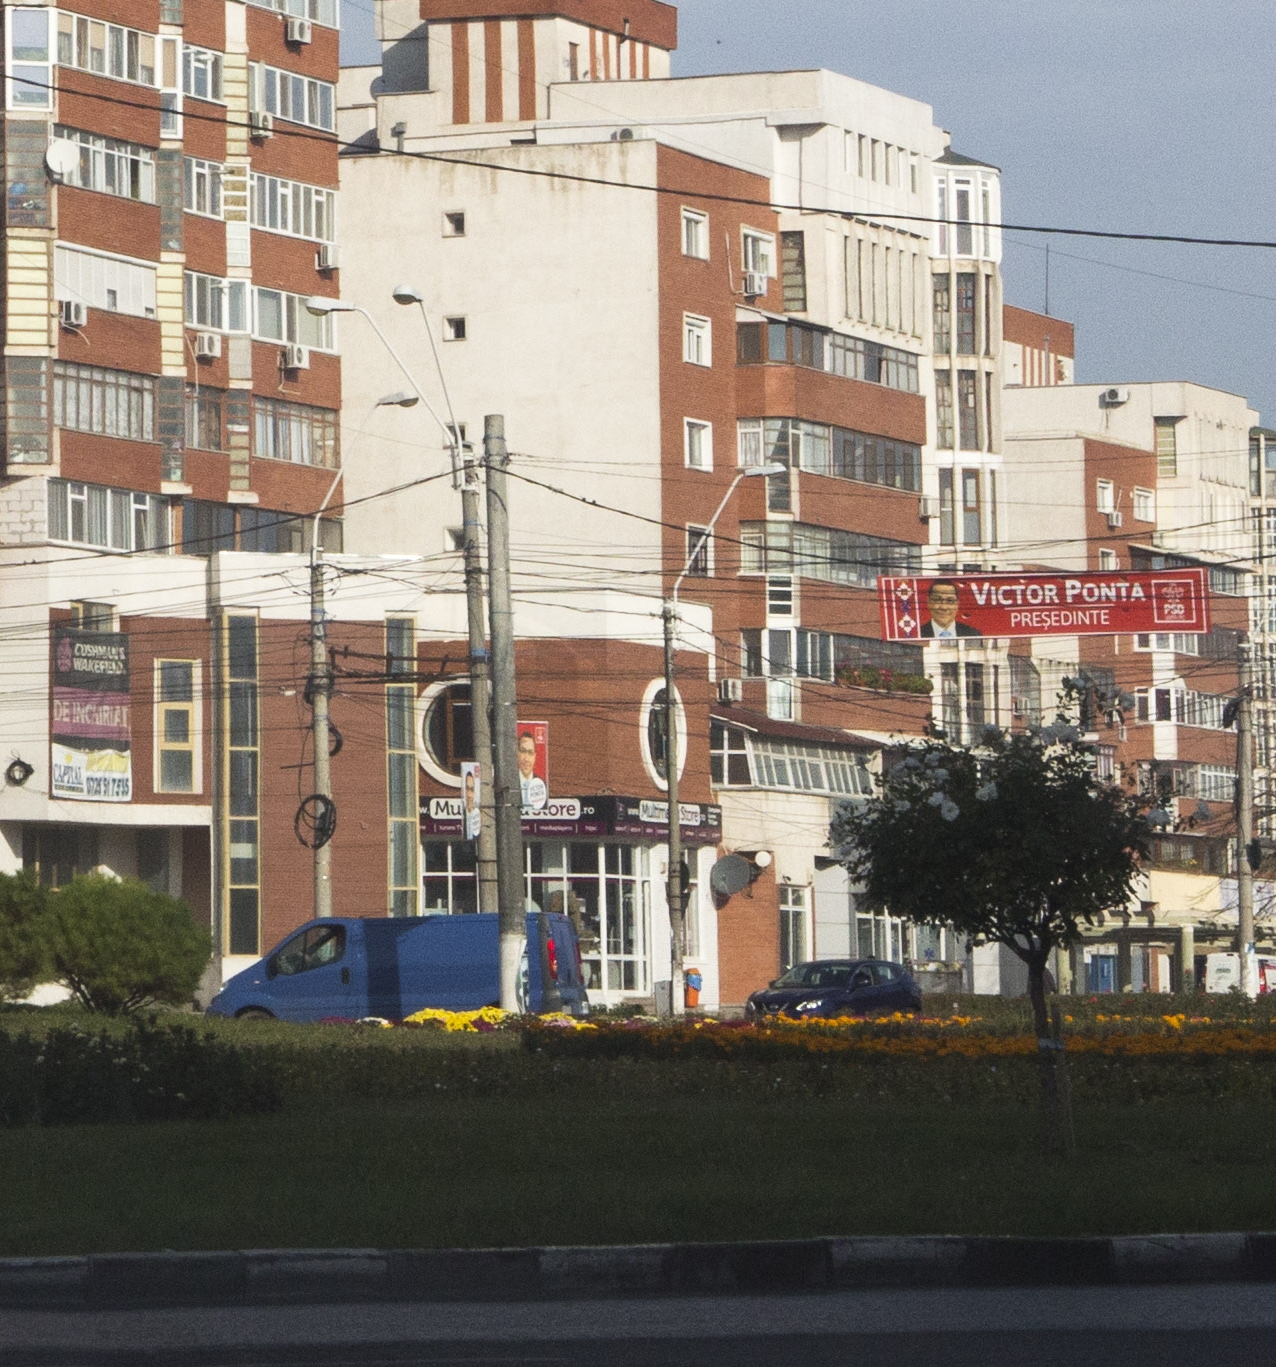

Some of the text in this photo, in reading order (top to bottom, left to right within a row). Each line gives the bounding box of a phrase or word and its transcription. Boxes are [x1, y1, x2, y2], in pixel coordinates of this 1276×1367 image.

[970, 579, 1146, 606] VICTOR PONTA
[1010, 610, 1110, 630] PREȘEDINTE
[1164, 604, 1185, 615] PSD
[53, 700, 70, 722] DE
